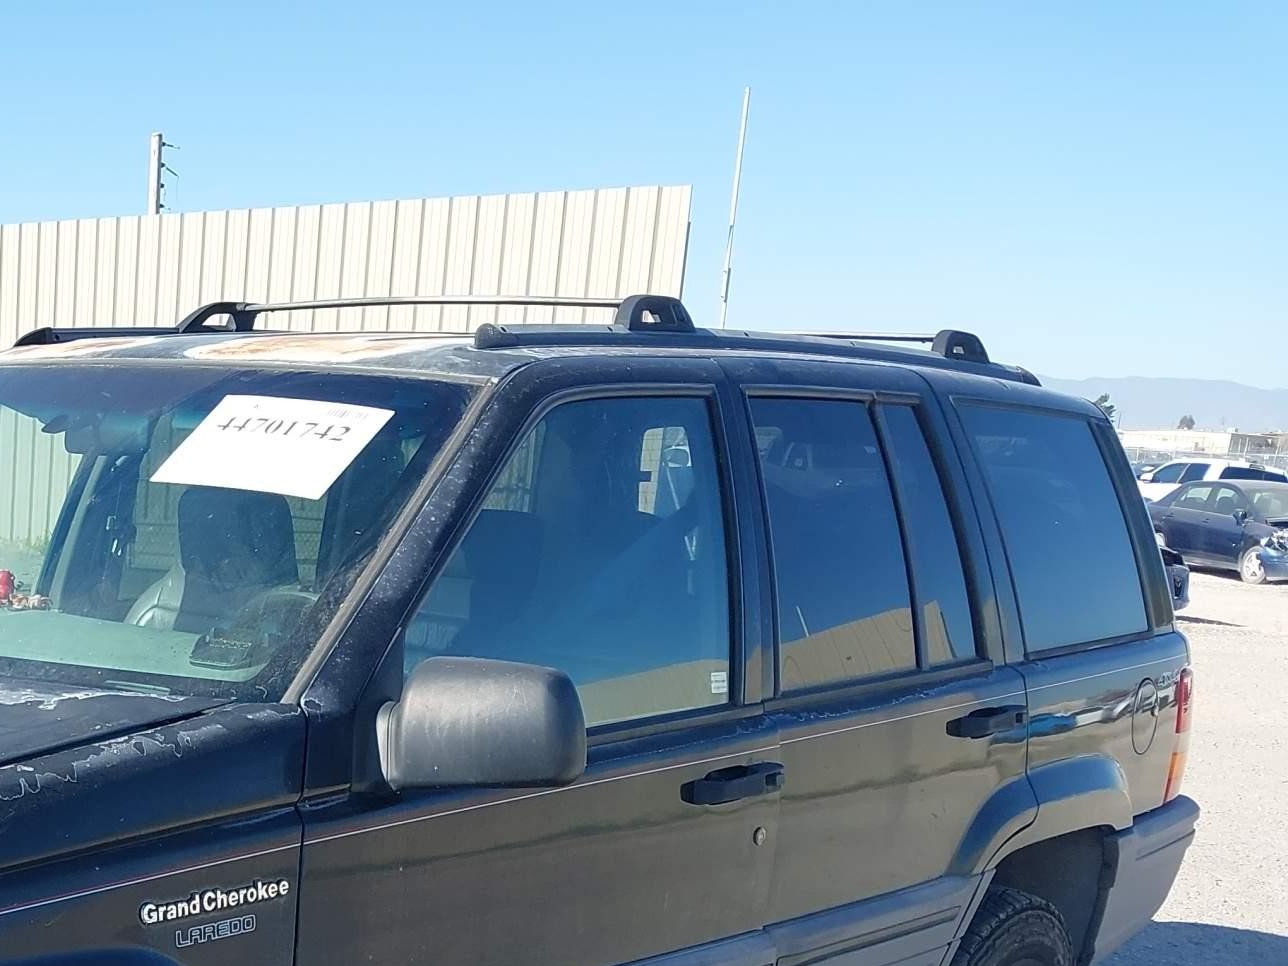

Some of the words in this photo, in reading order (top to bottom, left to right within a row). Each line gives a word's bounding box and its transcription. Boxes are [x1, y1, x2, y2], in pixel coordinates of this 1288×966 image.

[217, 416, 351, 441] 44701742
[142, 894, 201, 924] Grand
[202, 879, 290, 912] Cherokee
[175, 914, 257, 948] LAREDO
